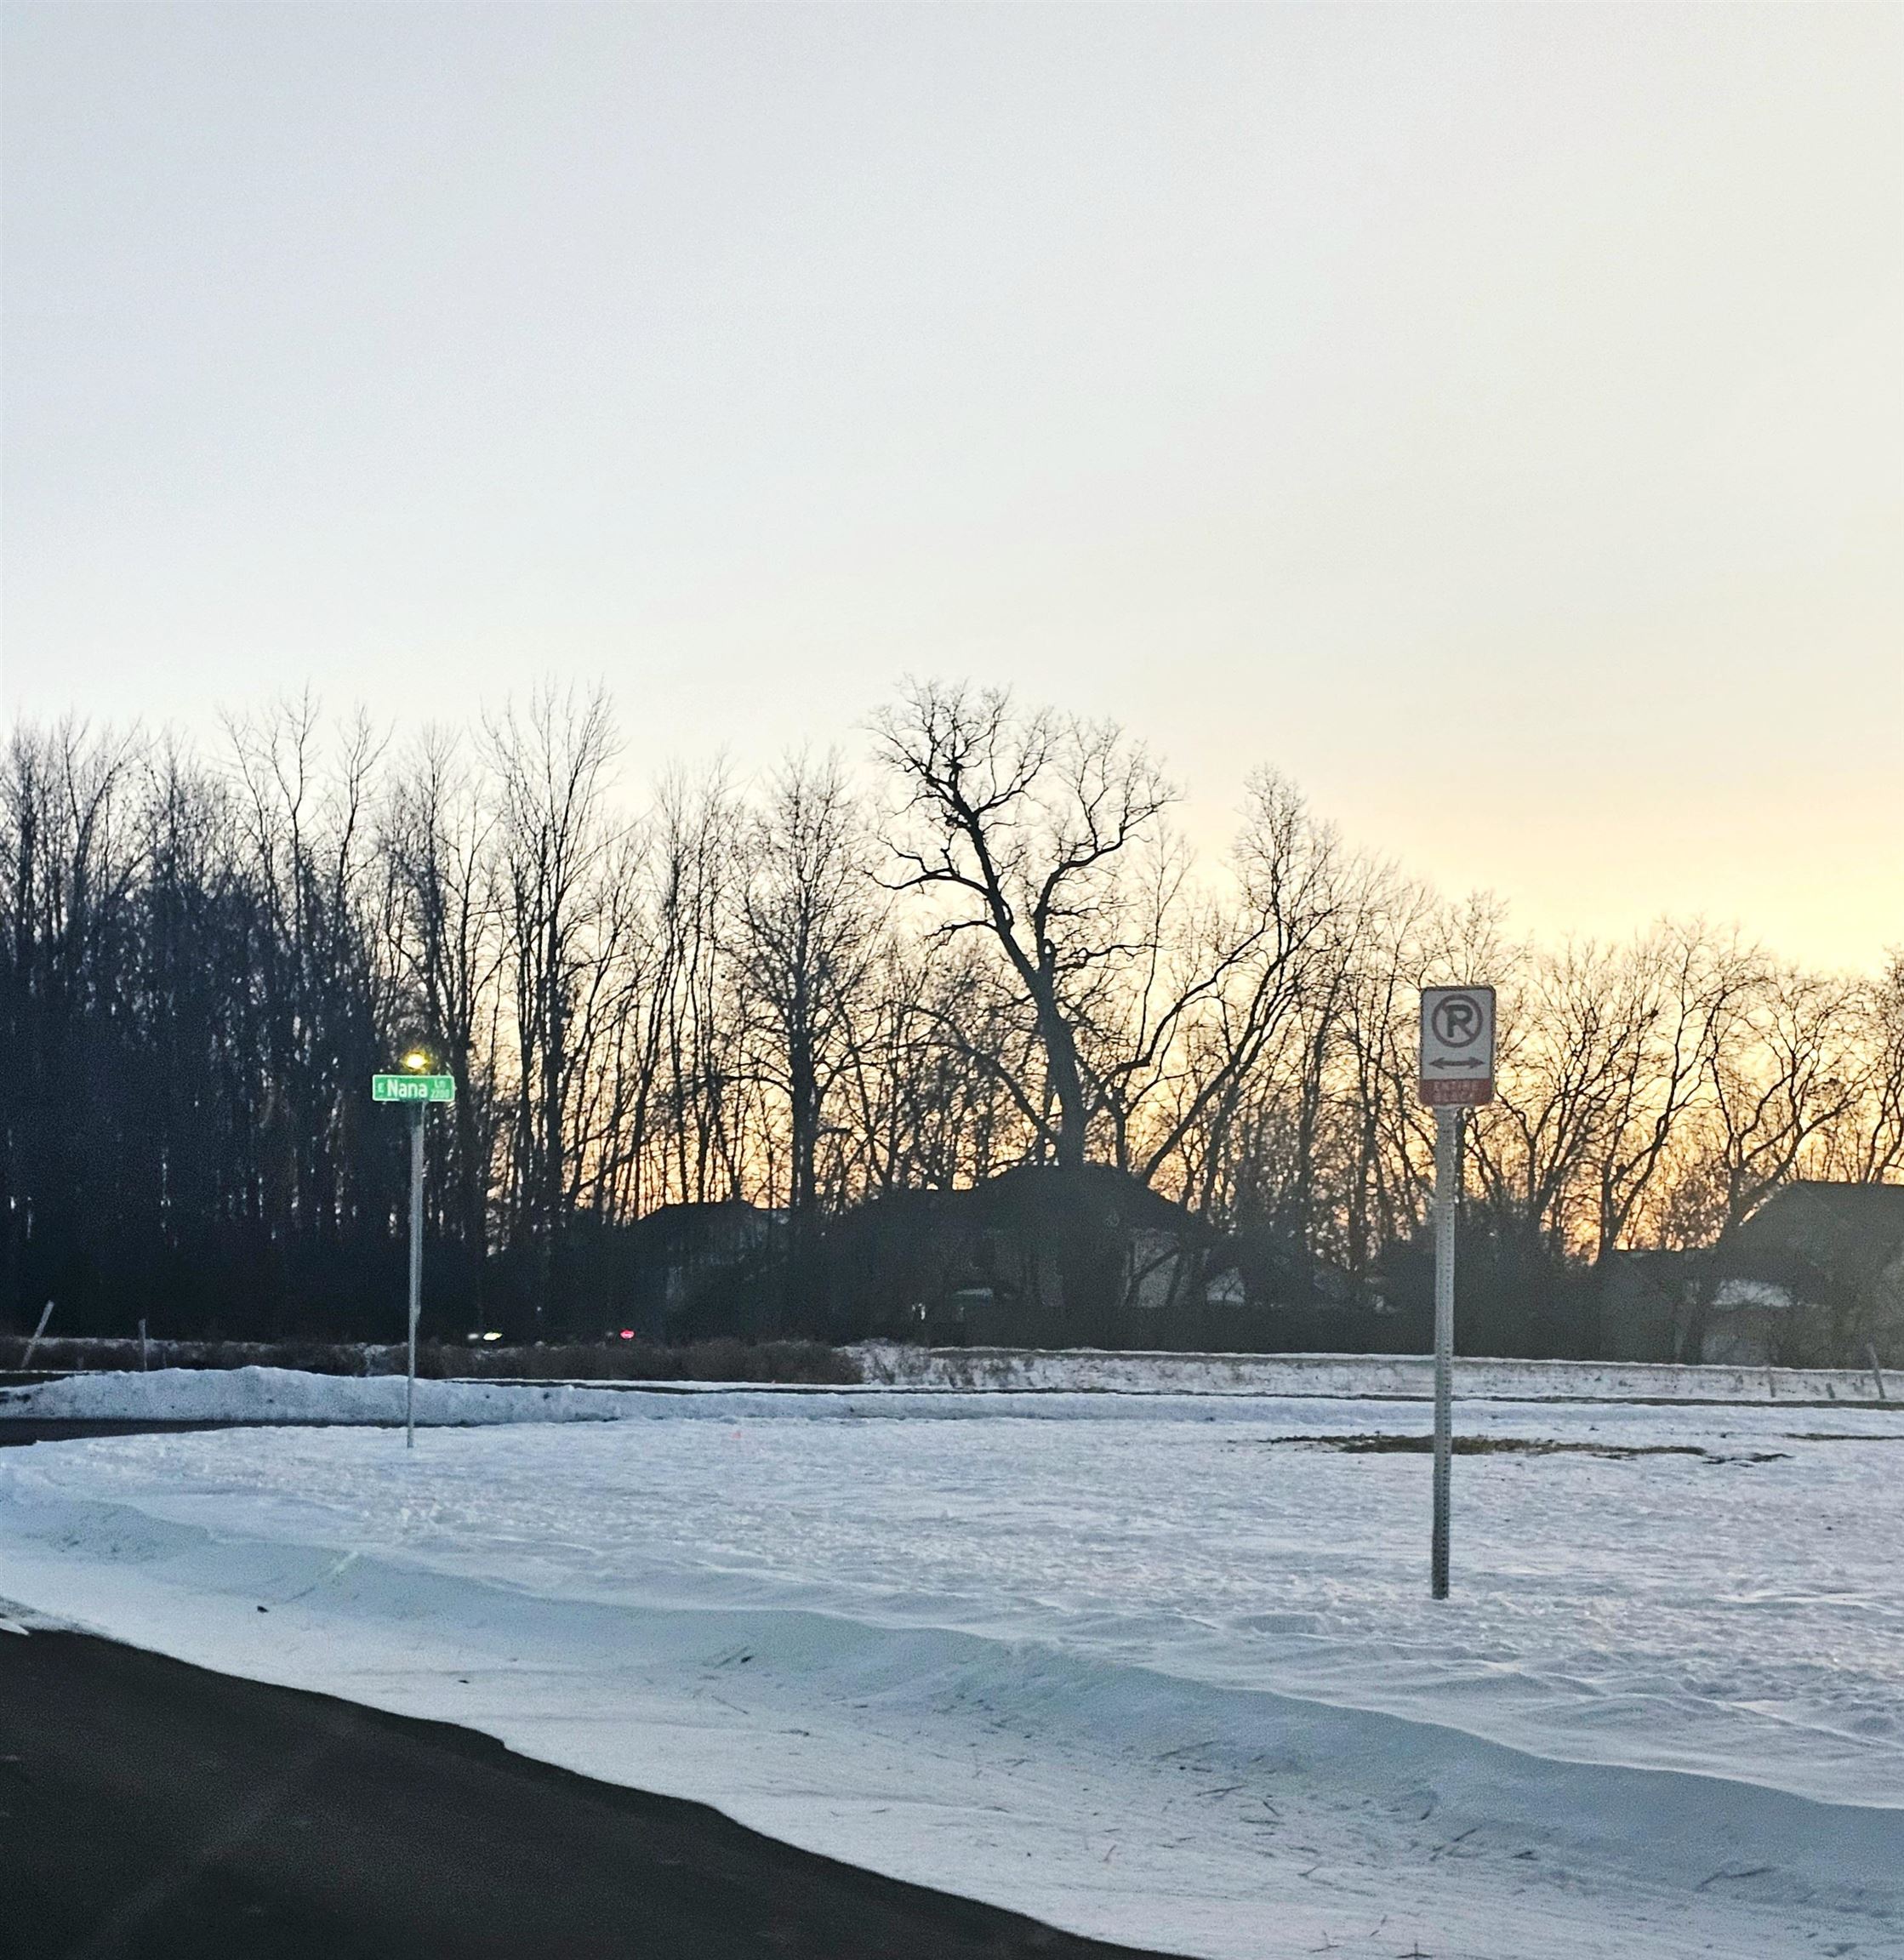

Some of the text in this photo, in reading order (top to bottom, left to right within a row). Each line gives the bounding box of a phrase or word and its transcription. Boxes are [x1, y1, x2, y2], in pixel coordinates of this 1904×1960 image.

[378, 1079, 446, 1098] E Nana Ln
